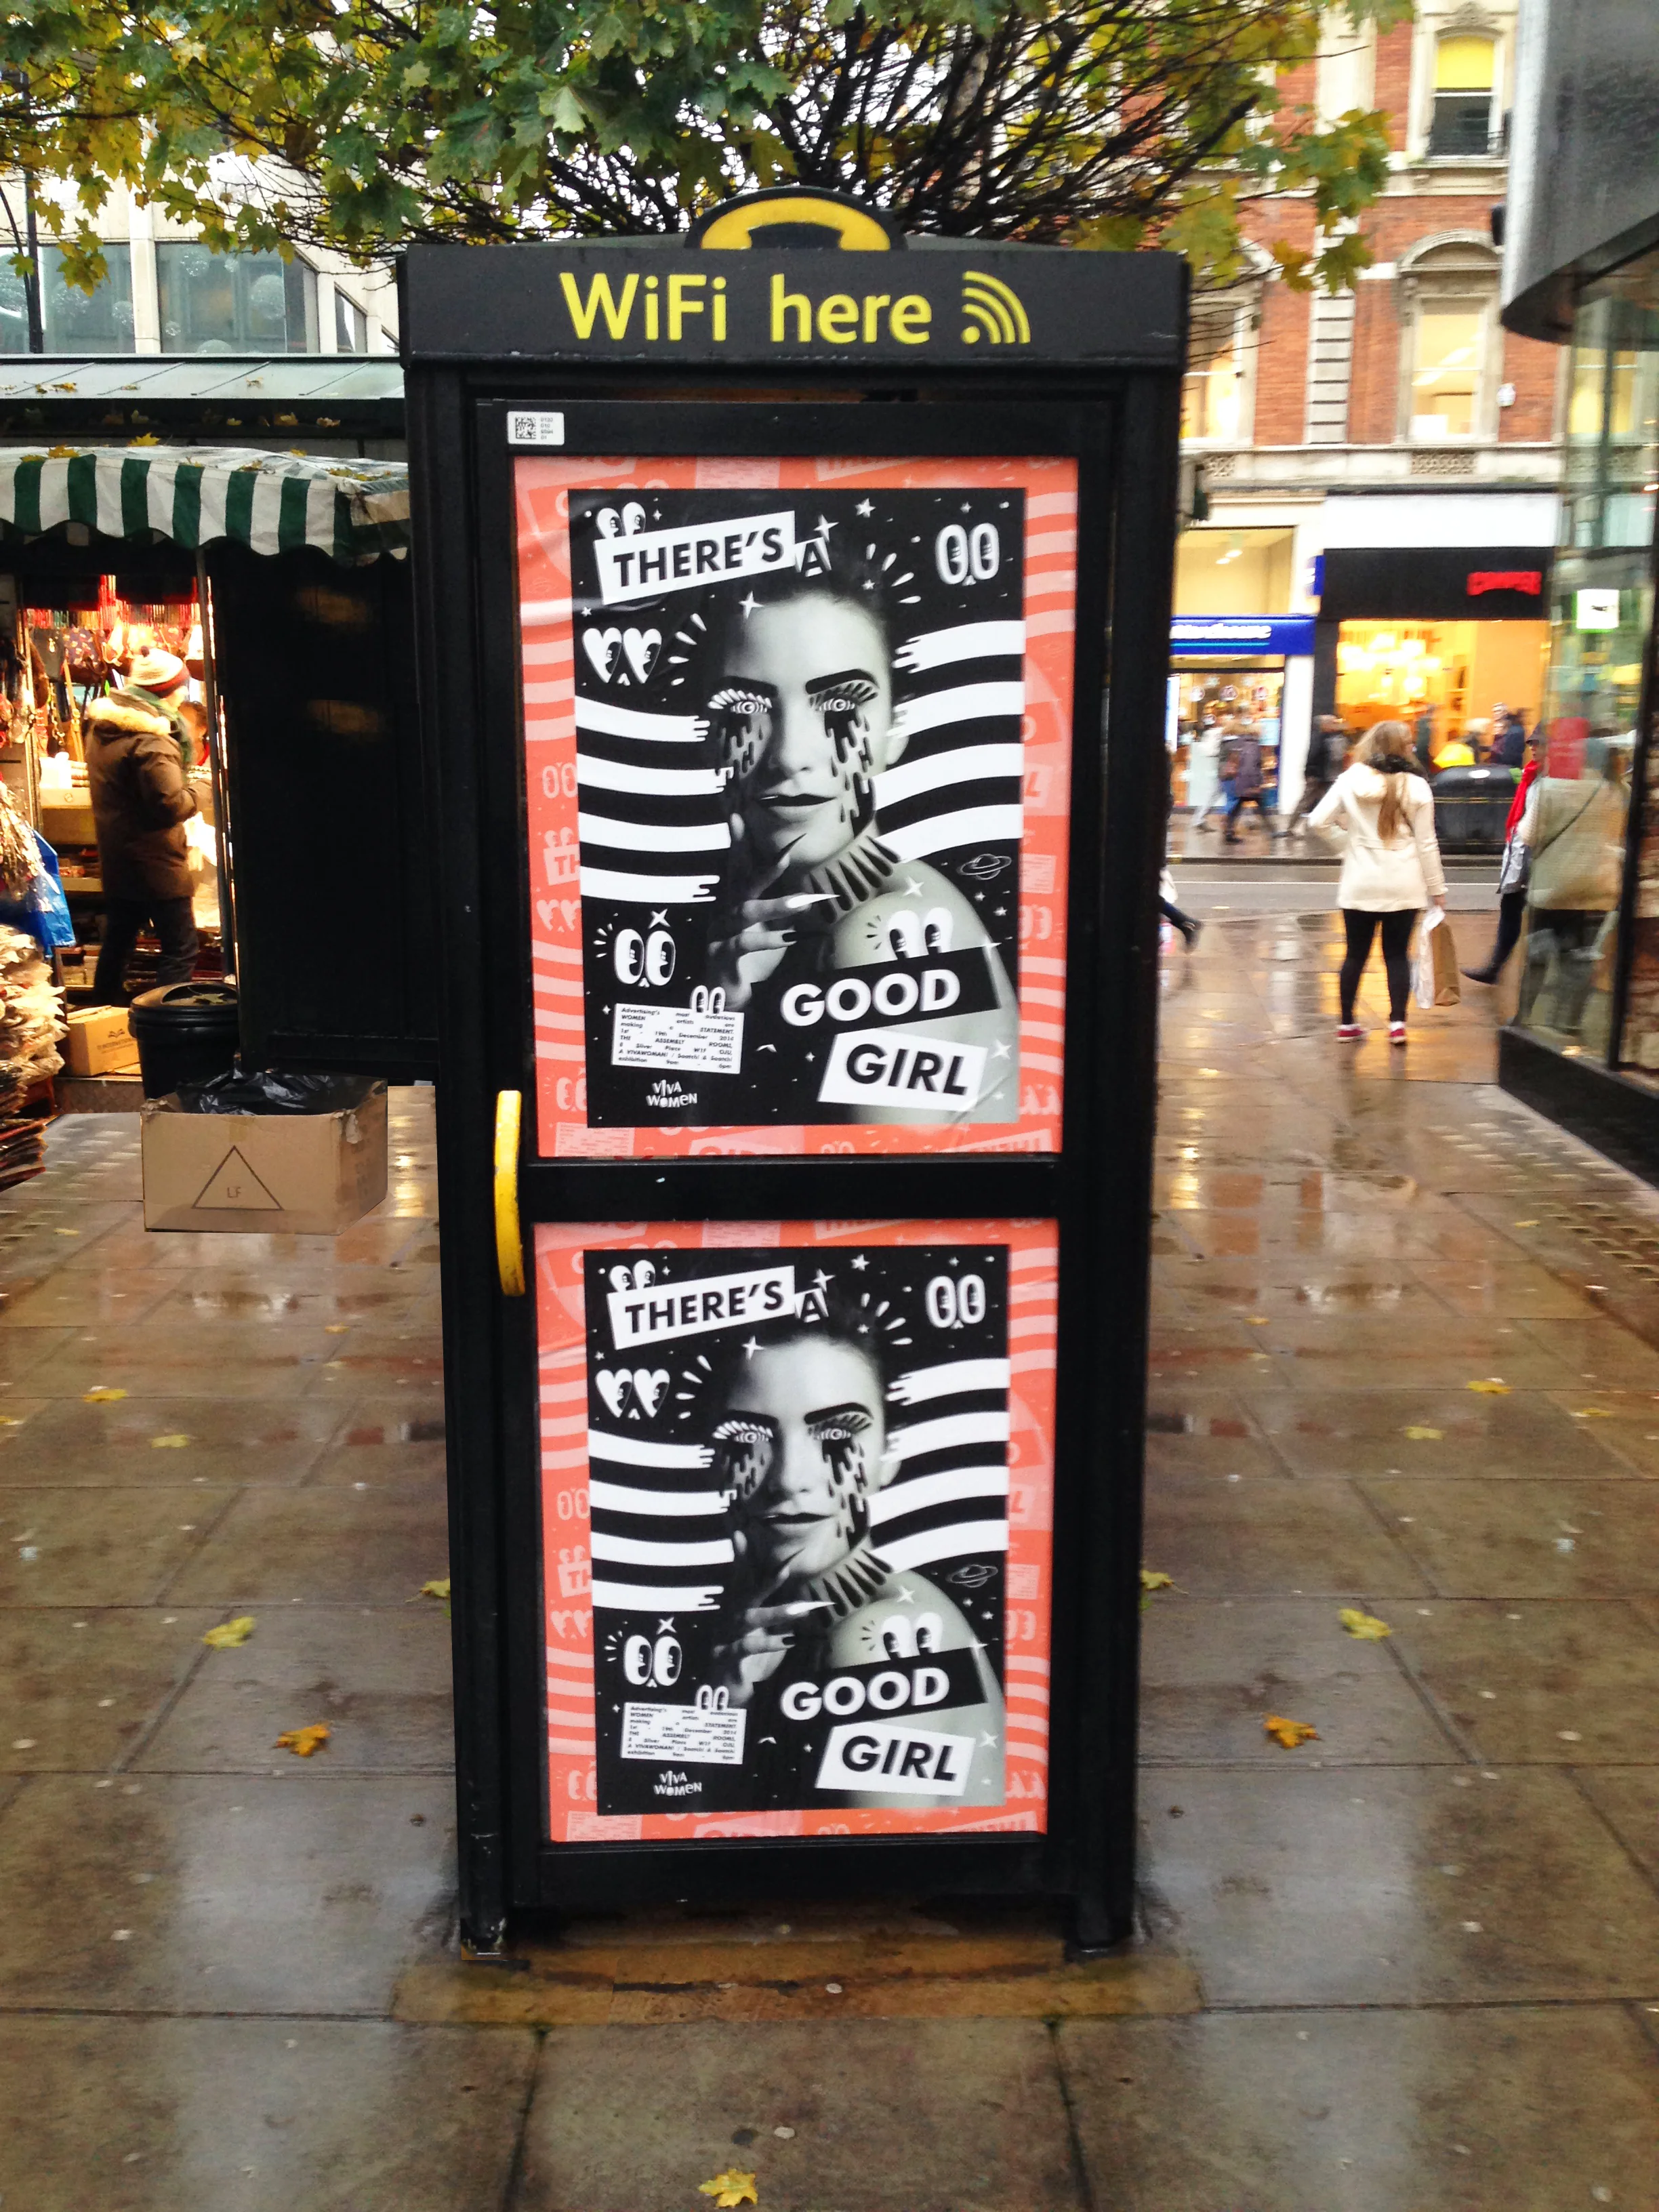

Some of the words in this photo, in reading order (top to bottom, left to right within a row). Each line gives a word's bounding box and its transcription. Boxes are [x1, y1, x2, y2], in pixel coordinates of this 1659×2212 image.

[560, 272, 726, 341] WiFi
[771, 273, 933, 344] here
[613, 527, 784, 588] THERE'S
[798, 539, 831, 577] A
[780, 969, 960, 1027] GOOD
[652, 1080, 682, 1097] VIVA
[846, 1044, 968, 1095] GIRL
[625, 1281, 783, 1334] THERE'S
[798, 1289, 828, 1323] A
[780, 1666, 950, 1721] GOOD
[659, 1770, 688, 1786] VIVA
[842, 1735, 958, 1782] GIRL
